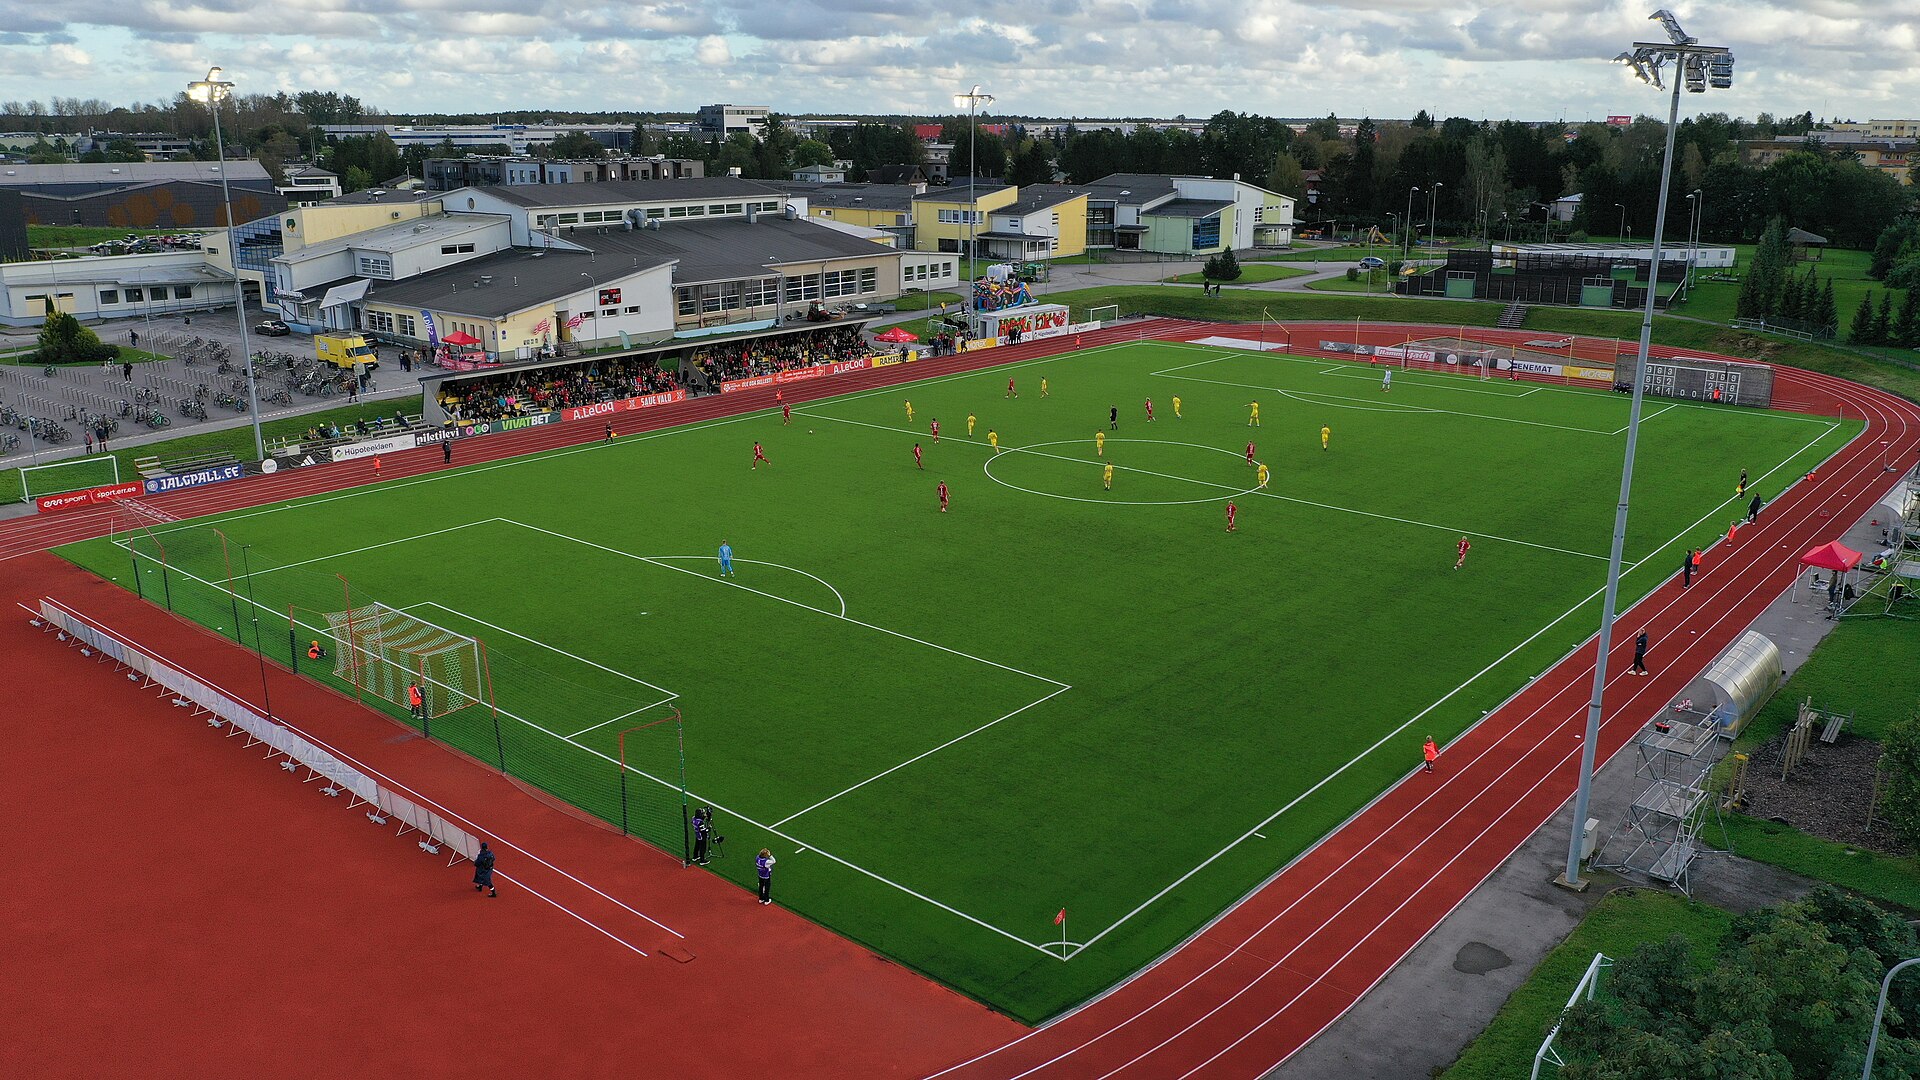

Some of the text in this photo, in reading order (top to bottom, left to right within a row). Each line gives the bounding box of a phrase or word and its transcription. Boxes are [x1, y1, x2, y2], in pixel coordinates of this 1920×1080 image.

[833, 359, 864, 374] A.LeCoq
[573, 401, 614, 421] A.LeCoq
[501, 413, 551, 431] VIVATBET
[416, 427, 459, 446] piletilevi
[344, 442, 394, 456] Hüpoteeklaen
[160, 466, 239, 490] JALGPALL.EE
[64, 494, 87, 504] SPORT
[97, 486, 137, 499] sport.err.ee
